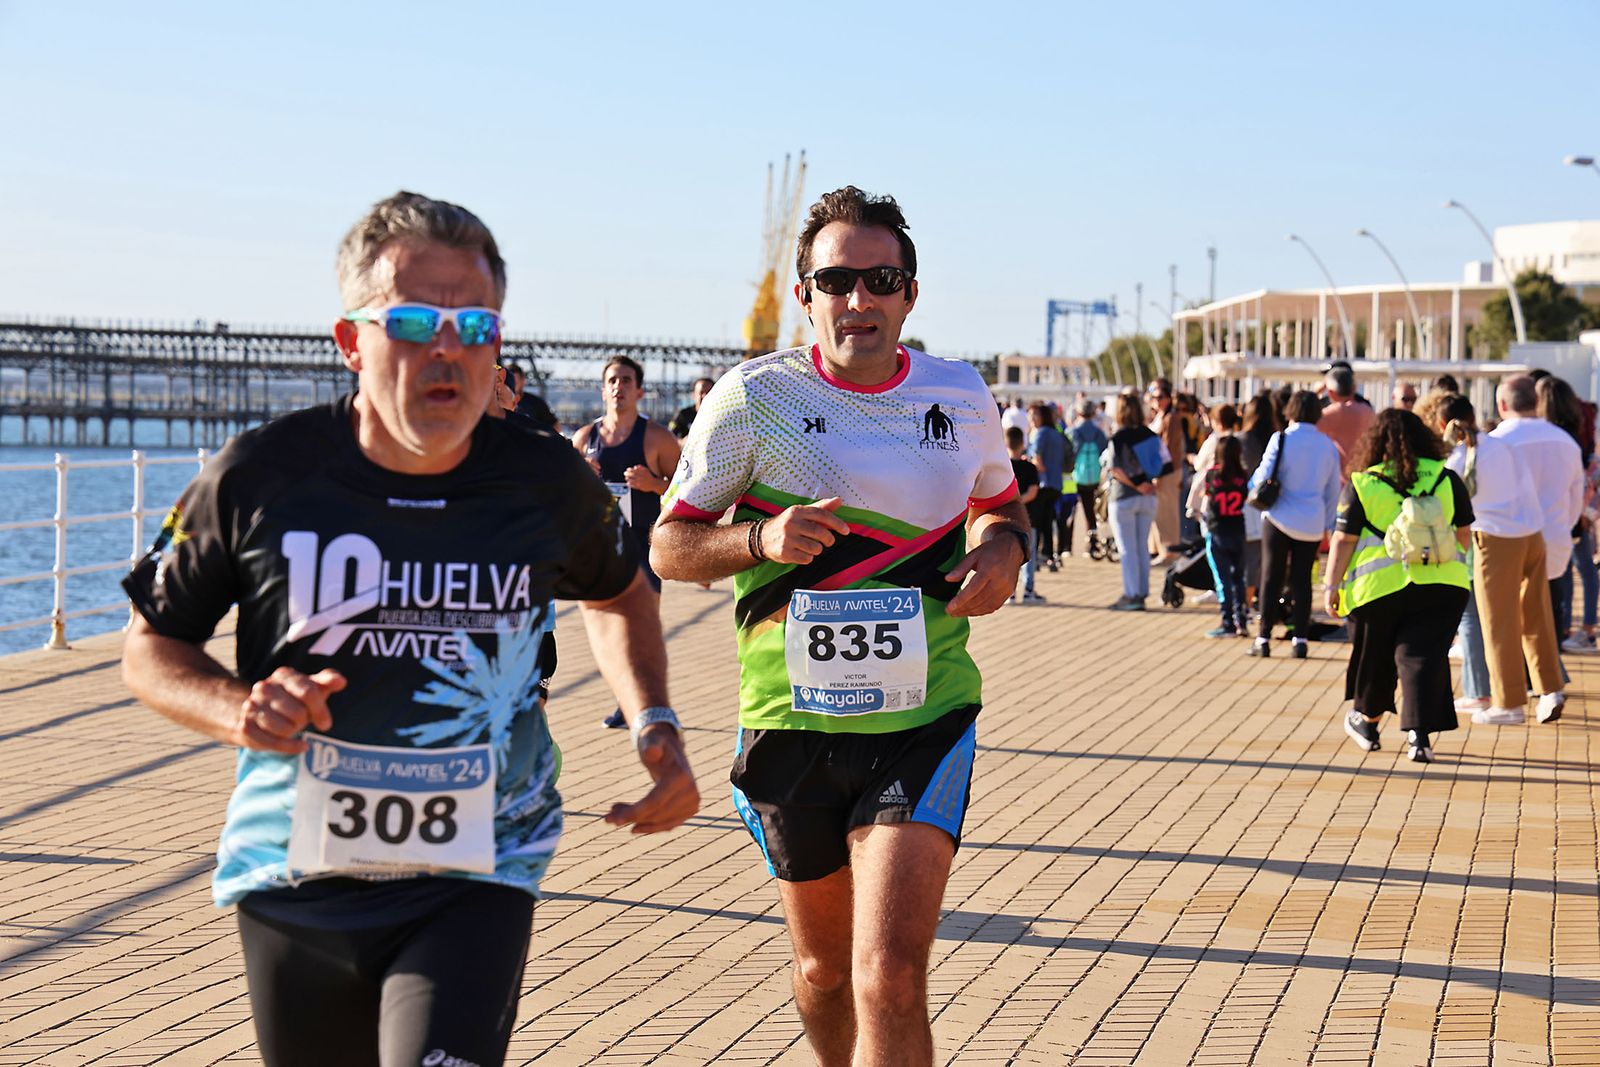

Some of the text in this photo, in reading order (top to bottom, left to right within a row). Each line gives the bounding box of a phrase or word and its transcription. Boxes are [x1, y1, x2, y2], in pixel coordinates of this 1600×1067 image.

[920, 441, 960, 451] FITNESS
[1215, 491, 1241, 516] 12
[382, 560, 531, 611] HUELVA
[810, 600, 840, 610] HUELVA
[844, 600, 887, 610] AVATEL
[888, 596, 915, 613] '24
[421, 611, 441, 625] DEL
[353, 632, 477, 661] AVATEL
[808, 622, 902, 661] 835
[812, 689, 874, 707] Wayalia
[386, 762, 448, 777] AVATEL
[449, 758, 484, 782] '24
[879, 795, 908, 804] adidas
[328, 791, 457, 844] 308
